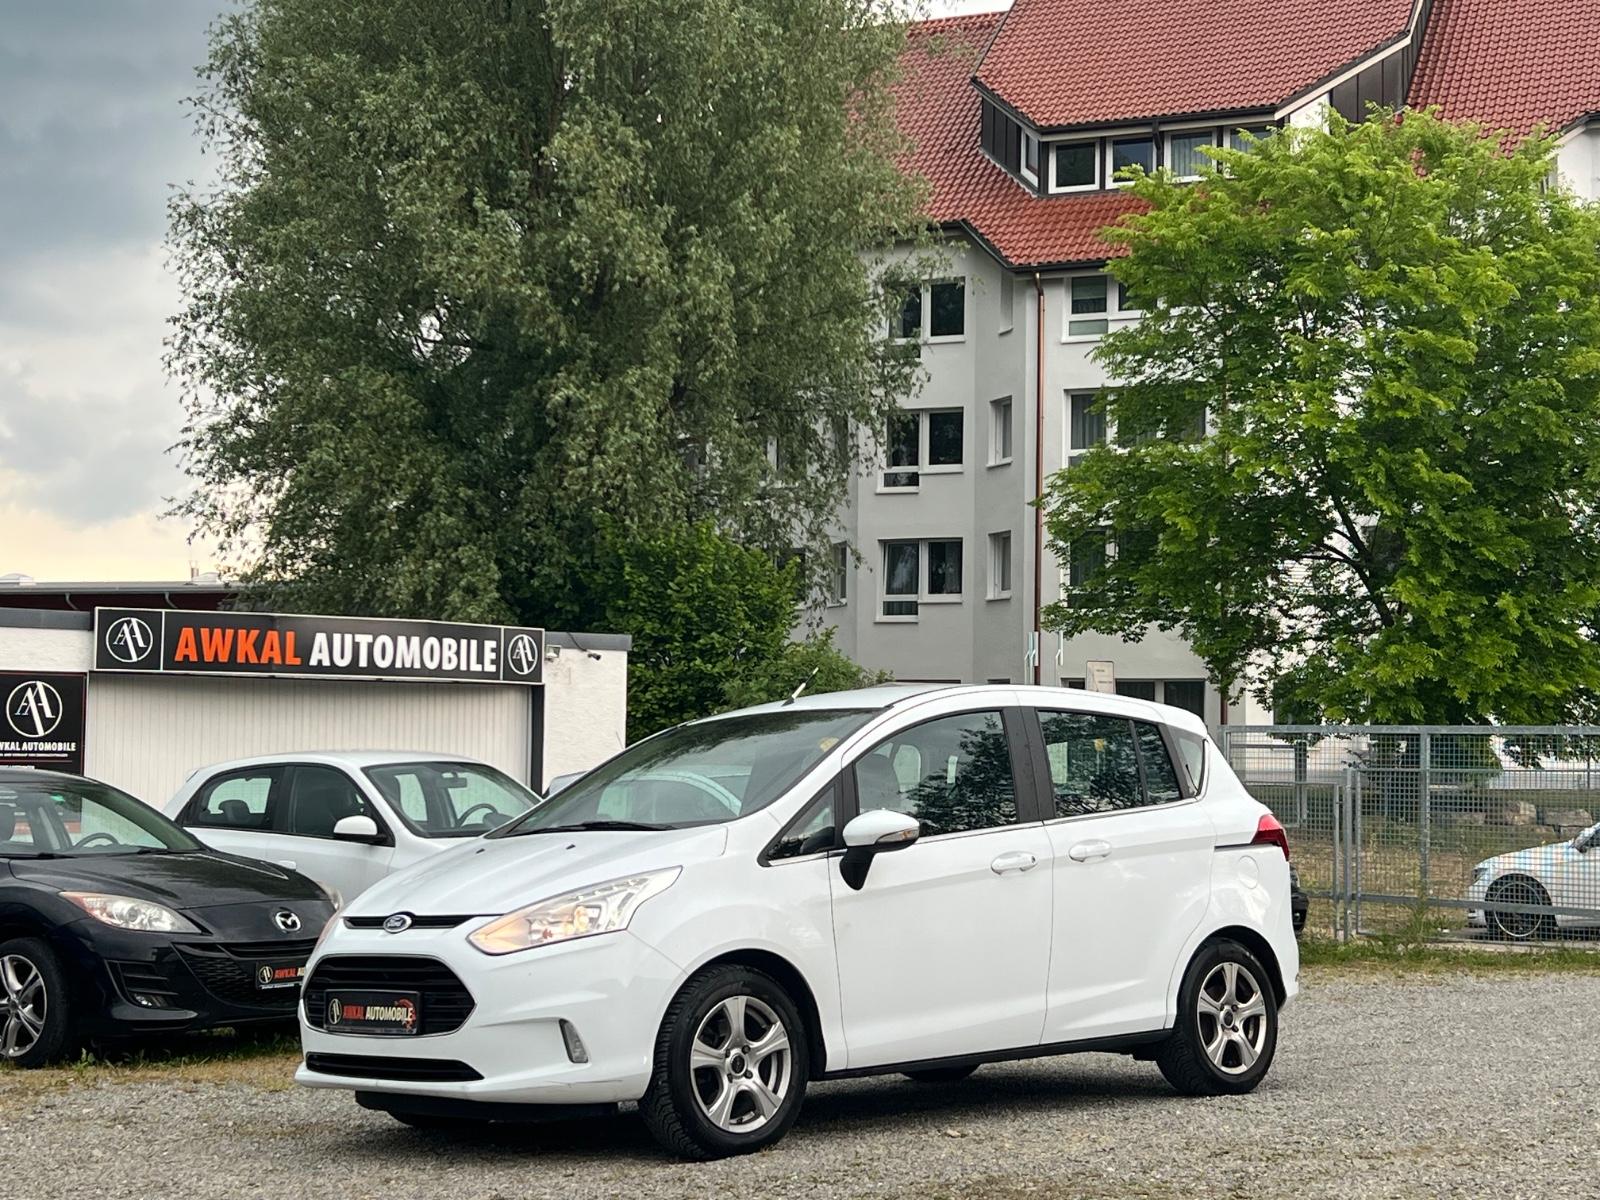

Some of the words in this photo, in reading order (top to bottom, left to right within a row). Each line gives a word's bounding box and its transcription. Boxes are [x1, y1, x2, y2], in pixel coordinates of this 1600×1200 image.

[174, 627, 302, 665] AWKAL
[308, 632, 497, 672] AUTOMOBILE
[22, 742, 77, 752] AUTOMOBILE
[365, 1006, 415, 1022] AUTOMOBILE
